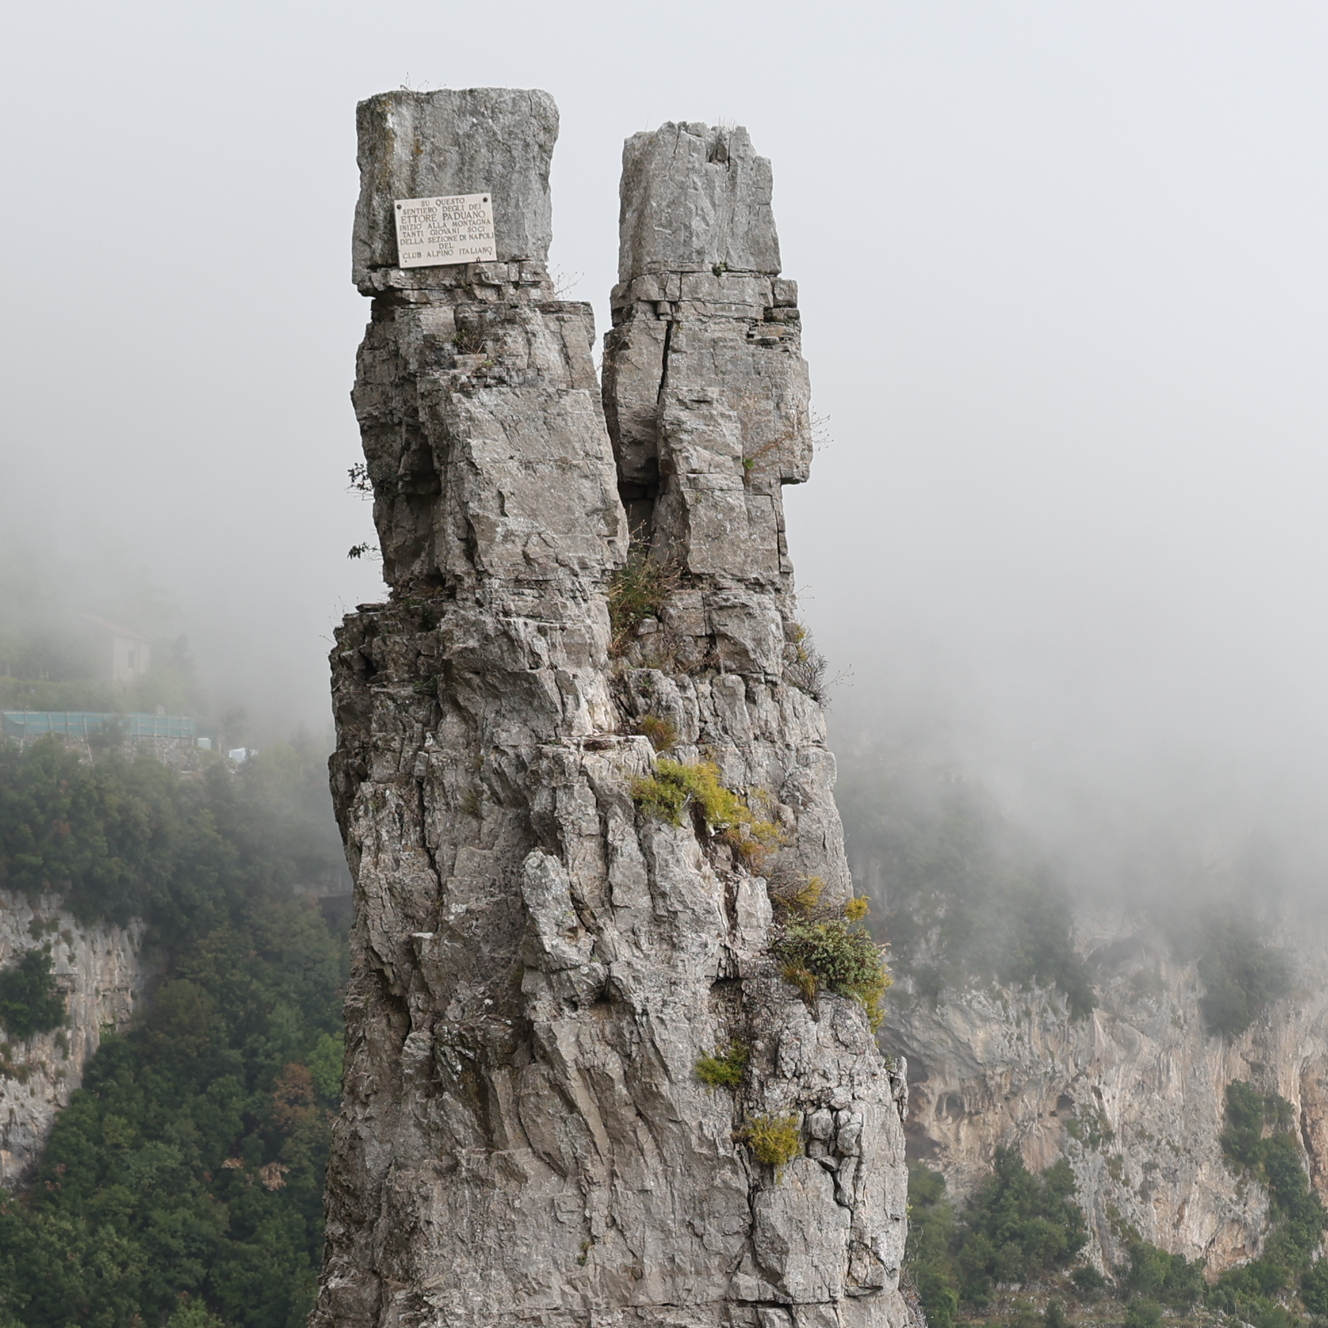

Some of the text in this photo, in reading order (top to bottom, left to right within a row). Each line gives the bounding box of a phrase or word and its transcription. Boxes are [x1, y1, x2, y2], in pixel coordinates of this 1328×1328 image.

[436, 198, 465, 207] QUESTO
[403, 207, 438, 215] SENTIERO
[400, 210, 486, 224] ETTORE PADUANO
[452, 219, 491, 227] MONTAGNA
[430, 228, 460, 236] GIOVANI
[428, 235, 458, 244] SEZIONE
[469, 232, 494, 240] NAPOLI
[427, 250, 454, 258] ALPINO
[460, 246, 492, 255] ITALIANO
